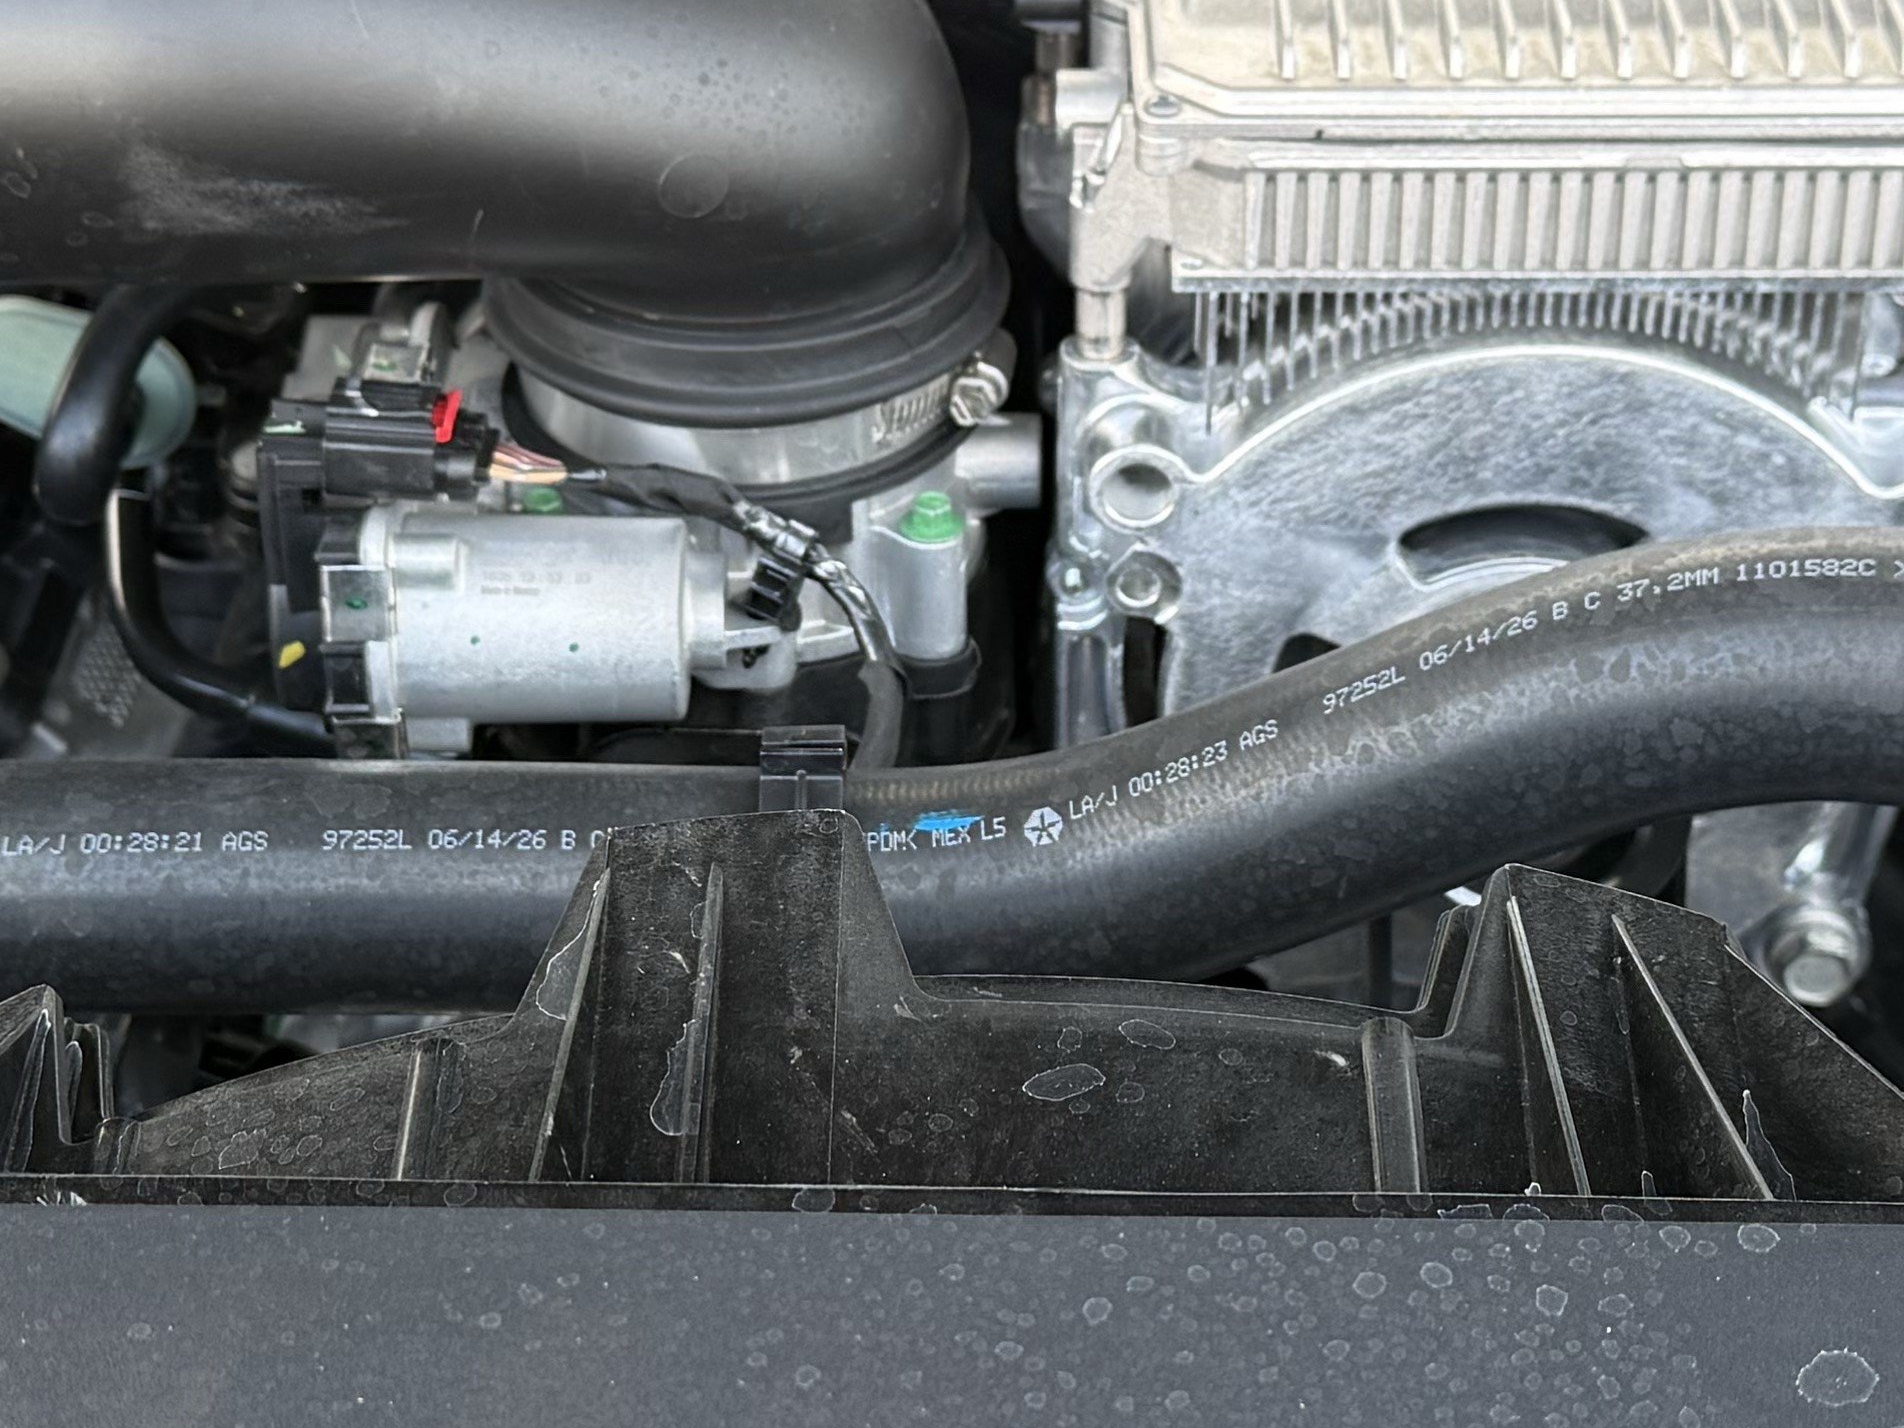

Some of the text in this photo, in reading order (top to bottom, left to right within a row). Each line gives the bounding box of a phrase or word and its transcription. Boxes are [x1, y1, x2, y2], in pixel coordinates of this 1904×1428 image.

[867, 828, 917, 852] PDM<
[932, 824, 971, 848] MEX
[1069, 785, 1118, 820] LA/J
[1128, 740, 1228, 797] 00:28:23
[1239, 719, 1279, 751] AGS
[1322, 666, 1406, 714] 97252L
[1419, 610, 1539, 671] 06/14/26
[1552, 601, 1569, 621] B
[1584, 592, 1602, 611] C
[1736, 558, 1877, 582] 1101582C
[0, 834, 67, 856] LA/J
[80, 831, 203, 854] 00:28:21
[220, 830, 269, 852] AGS
[321, 828, 412, 850] 97252L
[427, 828, 548, 850] 06/14/26
[560, 829, 577, 850] B
